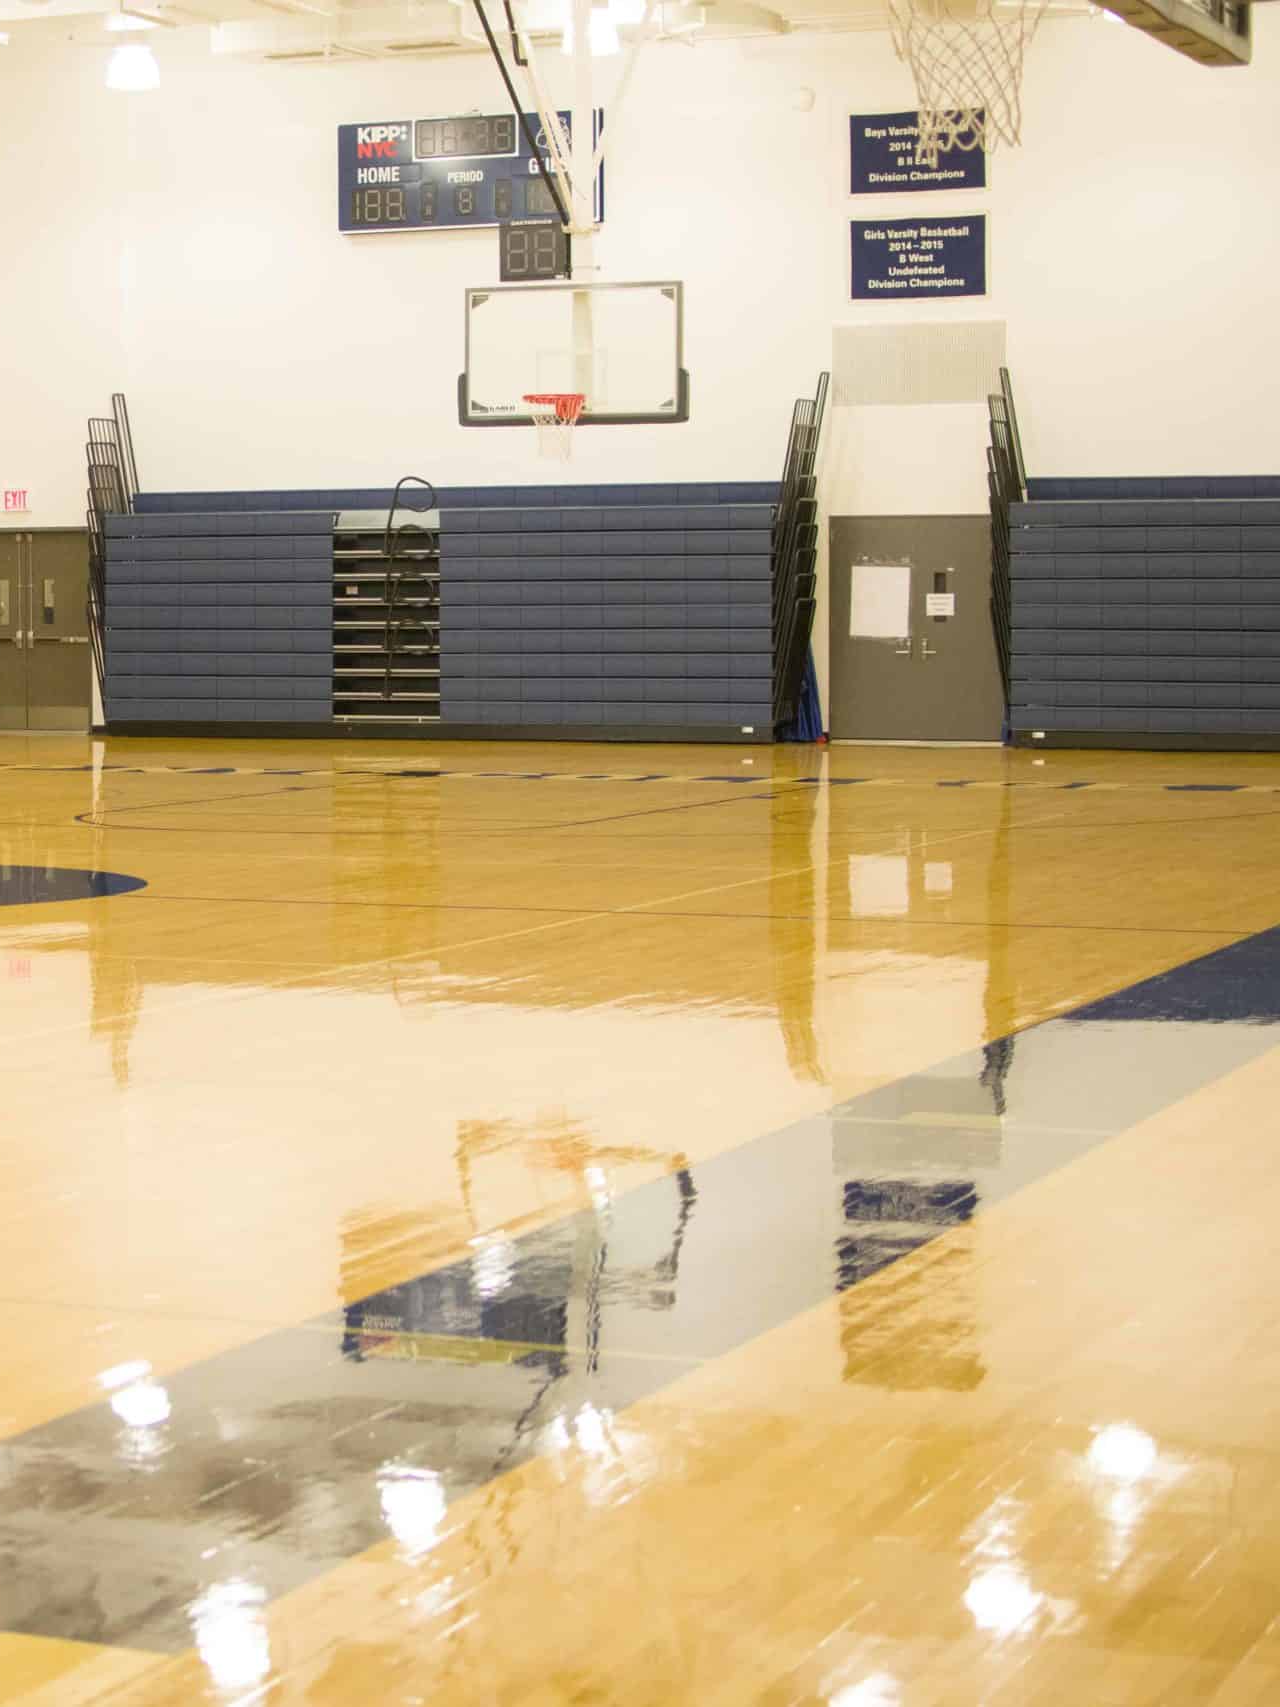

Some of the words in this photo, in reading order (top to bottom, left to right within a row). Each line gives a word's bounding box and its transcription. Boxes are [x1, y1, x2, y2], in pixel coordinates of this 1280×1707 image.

[864, 128, 886, 139] Boys
[888, 127, 918, 138] Varsity
[357, 142, 398, 159] NYC
[889, 142, 912, 151] 2014
[357, 166, 400, 184] HOME
[447, 170, 484, 183] PERIOD
[868, 171, 908, 182] Division
[910, 170, 965, 181] Champions
[863, 230, 885, 240] Girls
[887, 229, 918, 241] Varsity
[920, 226, 969, 237] Basketball
[899, 254, 906, 263] B
[908, 253, 933, 263] West
[888, 265, 945, 276] Undefeated
[868, 278, 908, 290] Division
[909, 277, 965, 289] Champions
[4, 490, 28, 510] EXIT
